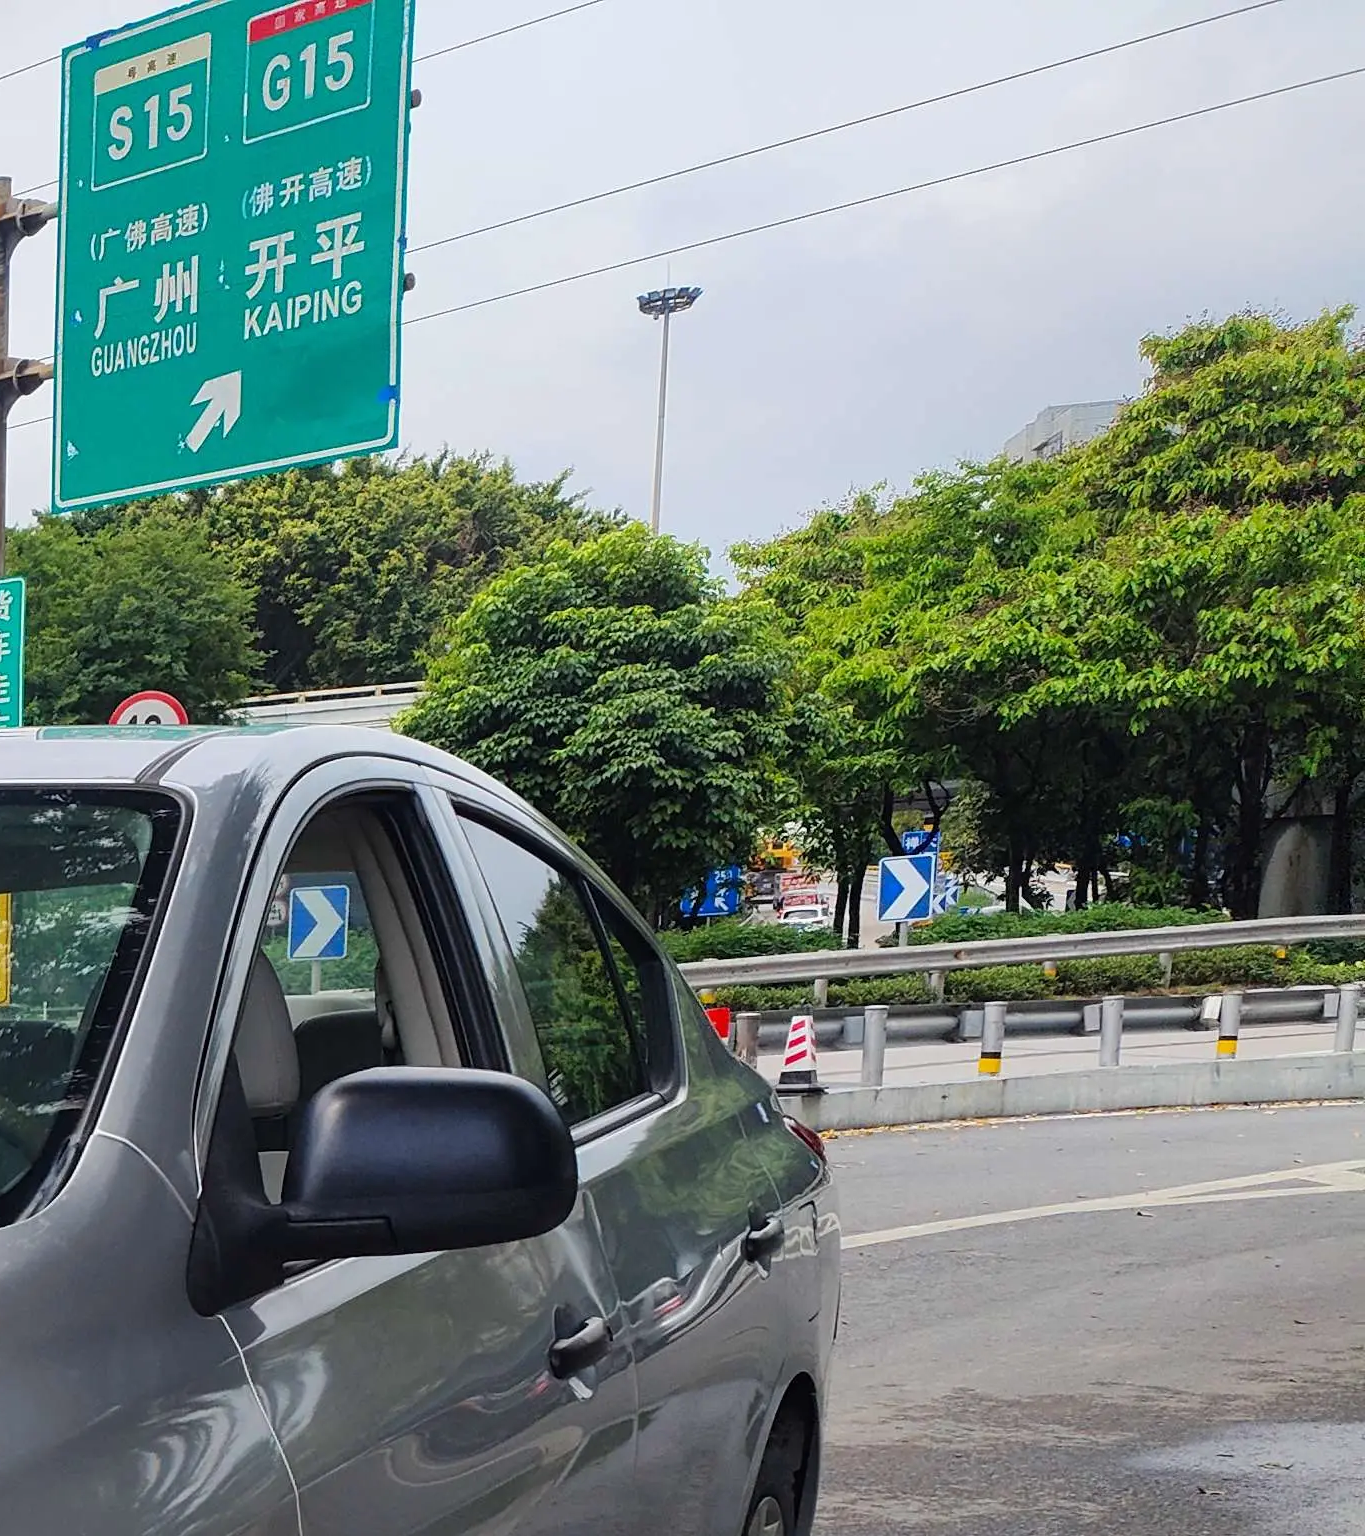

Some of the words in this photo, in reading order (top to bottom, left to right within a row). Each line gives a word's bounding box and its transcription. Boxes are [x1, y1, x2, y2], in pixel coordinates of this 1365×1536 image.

[262, 30, 355, 113] G15
[108, 83, 193, 161] S15
[242, 155, 372, 219] (佛开高速)
[90, 202, 209, 261] (广佛高速)
[244, 211, 365, 300] 开平
[94, 254, 199, 340] 广州
[243, 280, 362, 340] KAIPING
[91, 321, 197, 377] GUANGZHOU
